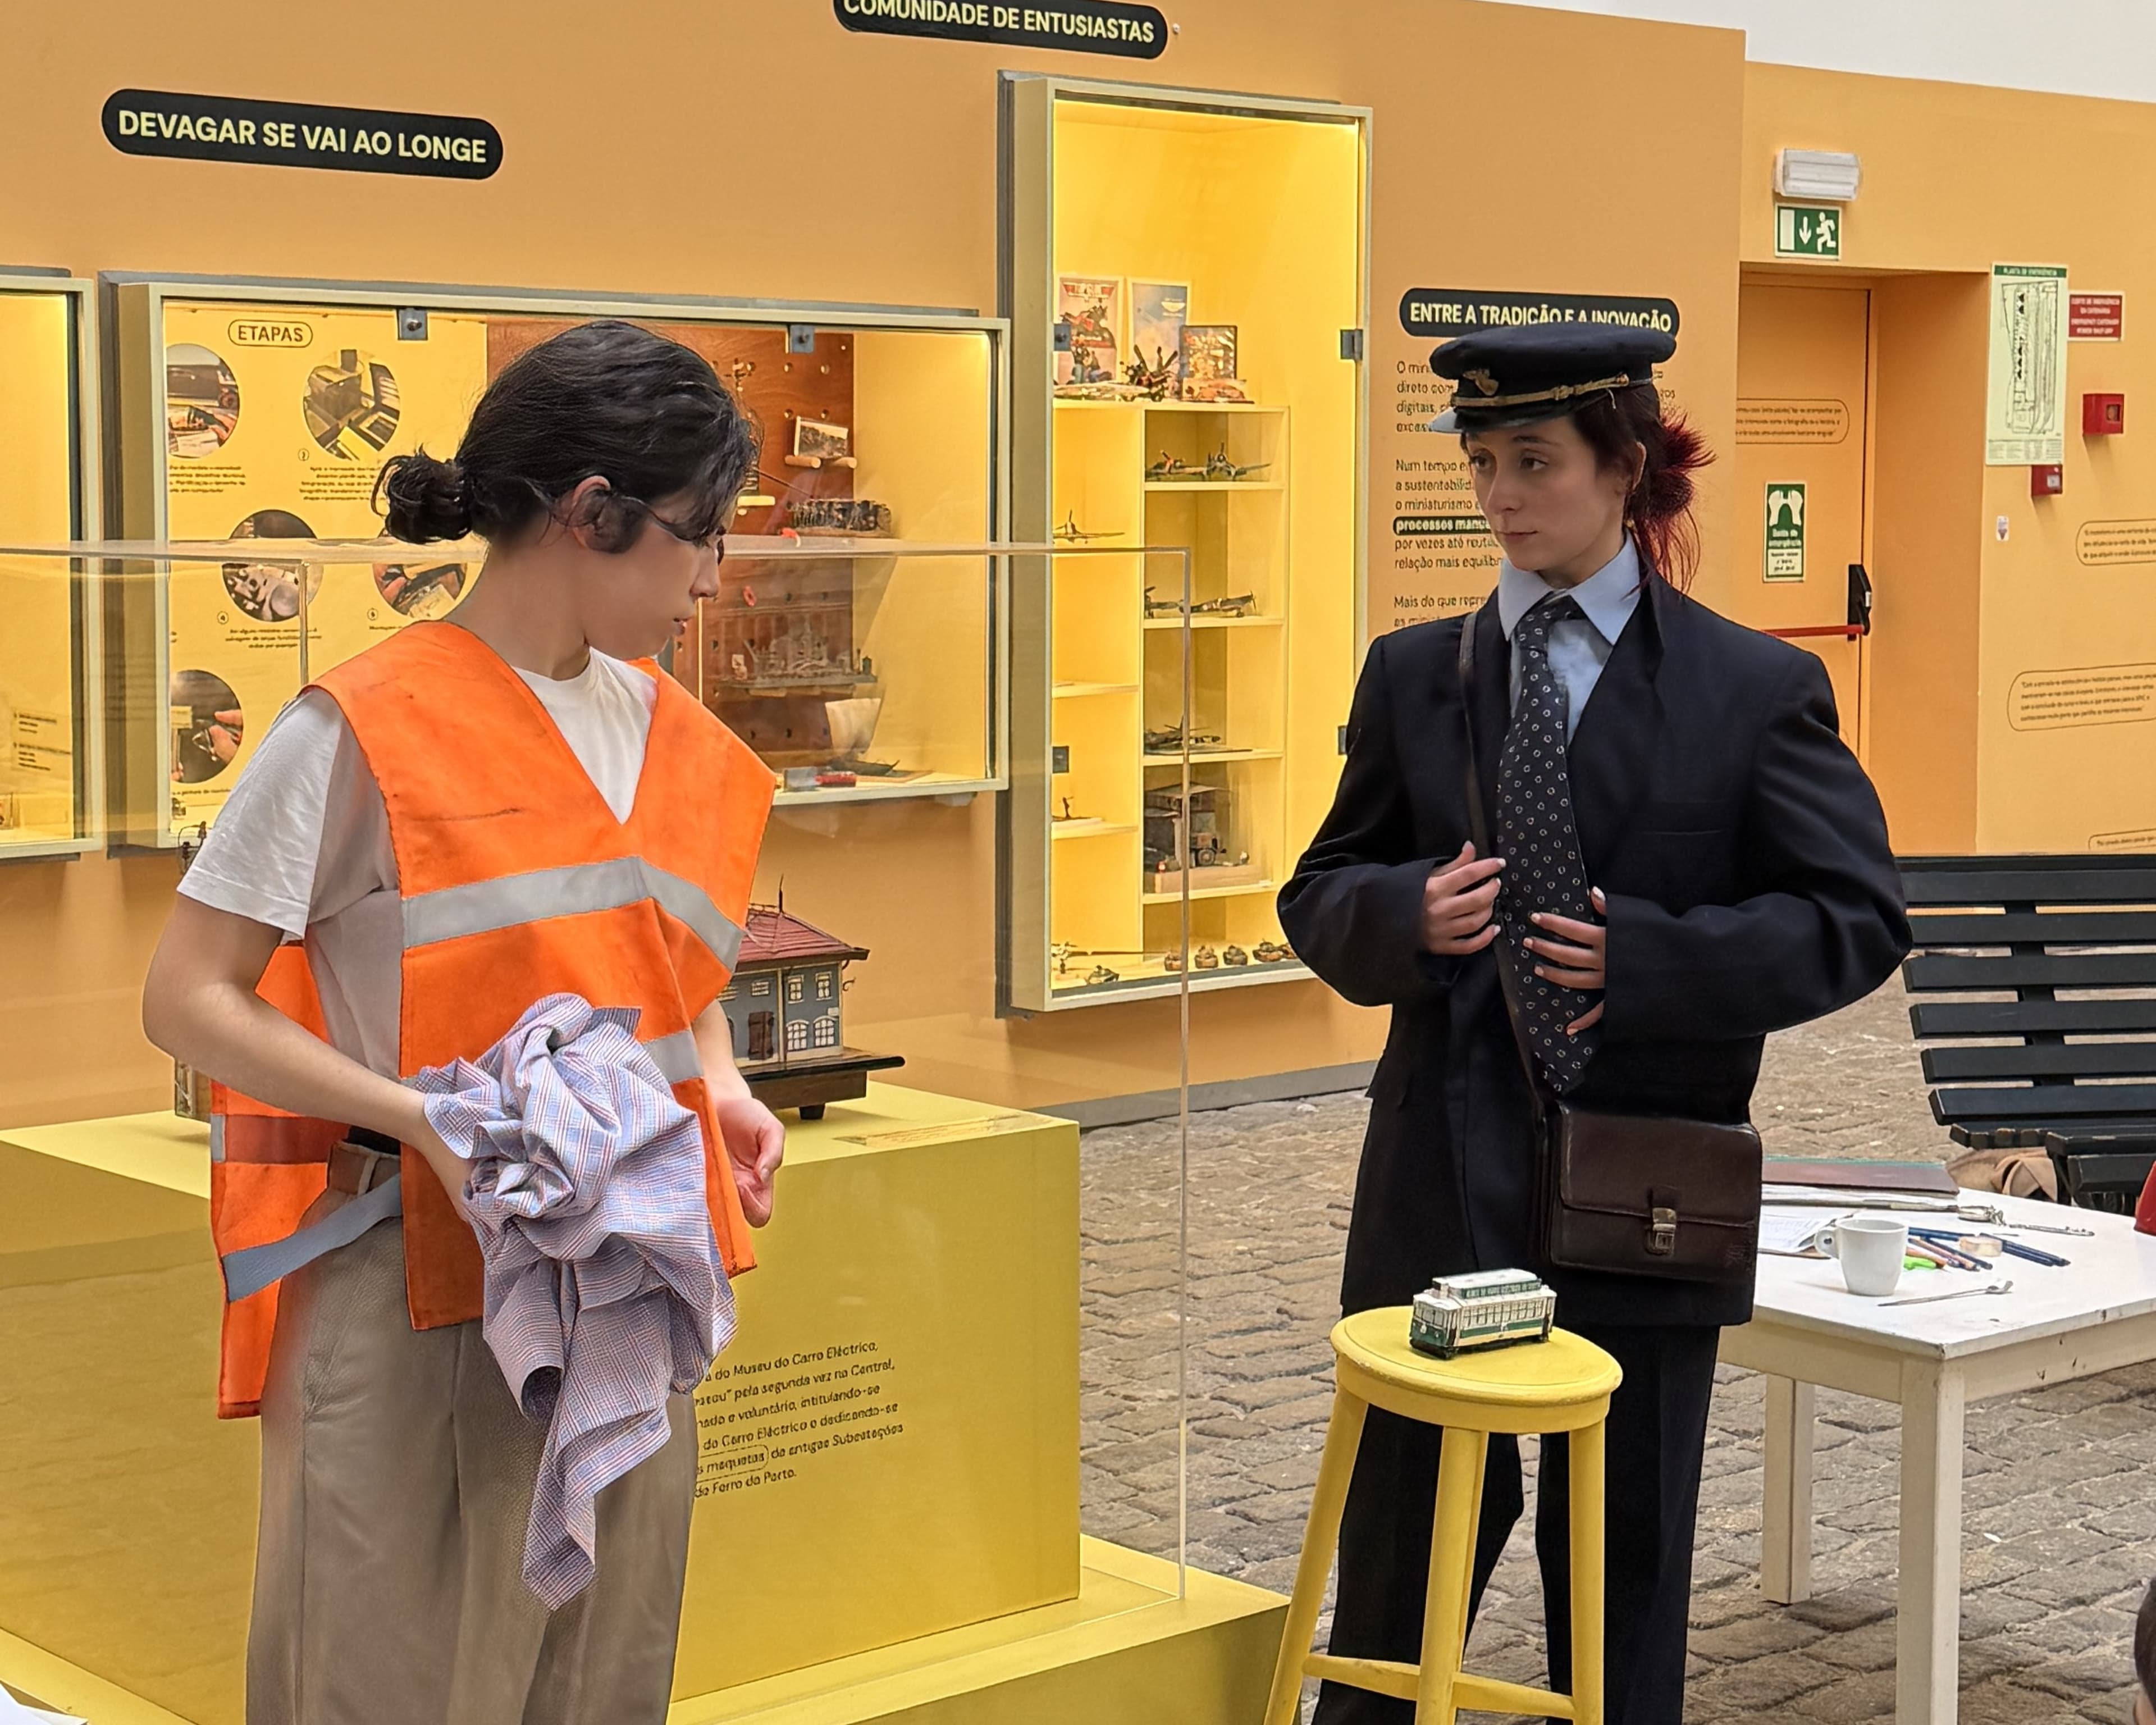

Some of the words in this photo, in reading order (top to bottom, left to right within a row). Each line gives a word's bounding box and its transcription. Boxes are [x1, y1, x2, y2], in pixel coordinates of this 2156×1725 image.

[844, 0, 989, 26] COMUNIDADE
[993, 8, 1020, 30] DE
[1024, 10, 1155, 43] ENTUSIASTAS
[118, 109, 257, 145] DEVAGAR
[263, 122, 296, 148] SE
[302, 125, 346, 152] VAI
[353, 129, 392, 156] AO
[398, 133, 487, 163] LONGE
[1410, 302, 1463, 323] ENTRE
[1464, 304, 1477, 324] A
[1480, 304, 1561, 326] TRADIÇÃO
[1578, 310, 1587, 323] A
[1592, 309, 1672, 332] INOVAÇÃO
[238, 325, 303, 343] ETAPAS
[1396, 360, 1406, 374] O
[1396, 380, 1428, 394] direto
[1396, 459, 1420, 471] Num
[1423, 460, 1457, 474] tempo
[1396, 481, 1402, 491] a
[1396, 501, 1403, 510] o
[1405, 498, 1473, 510] miniaturismo
[1396, 519, 1454, 534] processos
[1395, 540, 1413, 551] por
[1415, 539, 1445, 549] vezes
[1447, 536, 1464, 549] até
[1395, 556, 1433, 572] relação
[1436, 556, 1460, 568] mais
[1394, 595, 1419, 608] Mais
[1420, 595, 1435, 608] do
[1437, 597, 1457, 609] que
[715, 1368, 730, 1380] do
[733, 1361, 772, 1376] Museu
[774, 1357, 789, 1369] do
[792, 1351, 824, 1365] Carro
[734, 1385, 759, 1403] pela
[761, 1375, 810, 1395] segunda
[813, 1372, 832, 1384] vez
[738, 1400, 797, 1421] voluntário,
[801, 1385, 880, 1408] intitulando-se
[703, 1438, 719, 1450] do
[721, 1433, 754, 1447] Carro
[757, 1421, 808, 1440] Eléctrico
[820, 1403, 899, 1427] dedicando-se
[788, 1439, 830, 1455] antigas
[833, 1423, 904, 1446] Subestações
[712, 1480, 743, 1494] Ferro
[745, 1475, 761, 1487] do
[764, 1468, 797, 1484] Porto.
